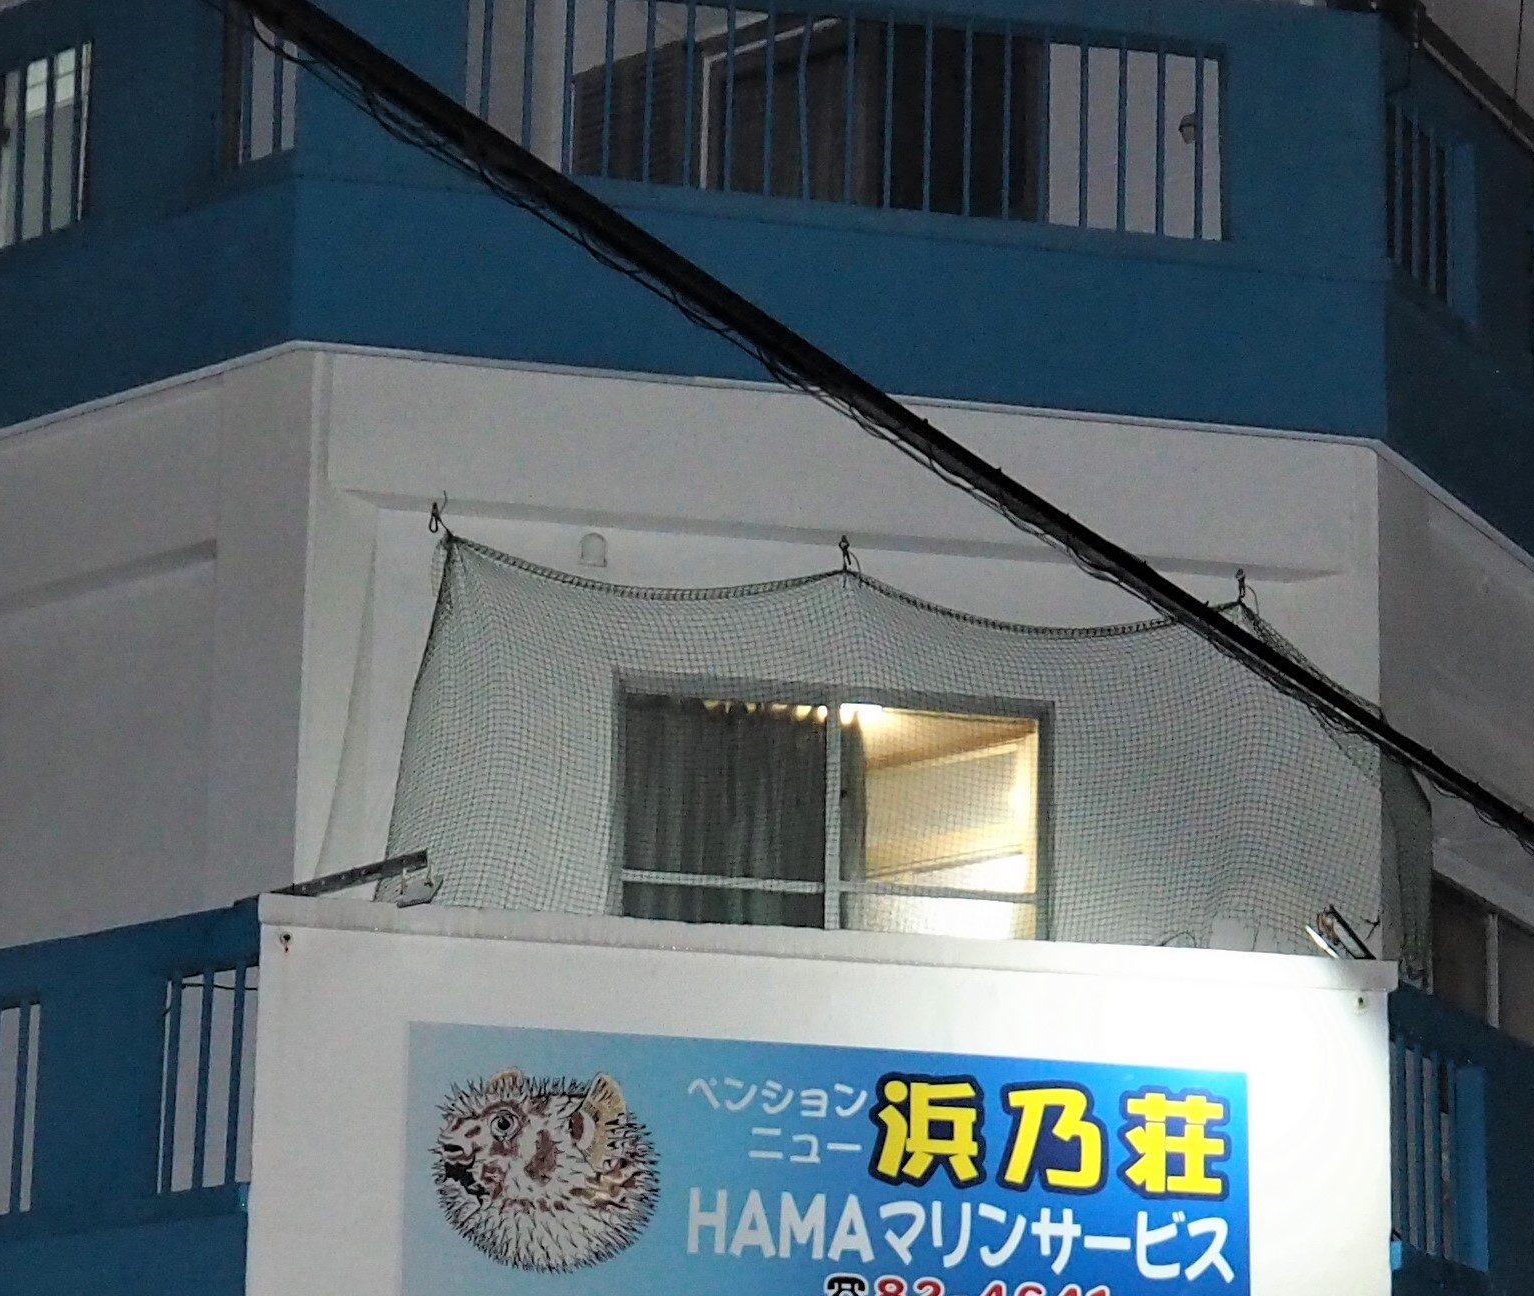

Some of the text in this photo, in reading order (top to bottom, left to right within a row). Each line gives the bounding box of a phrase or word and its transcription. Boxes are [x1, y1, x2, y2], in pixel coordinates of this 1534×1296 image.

[687, 1077, 868, 1118] ペンション
[748, 1126, 863, 1164] ニュー
[875, 1077, 1226, 1197] 浜乃荘
[687, 1186, 1236, 1284] HAMAマリンサービス
